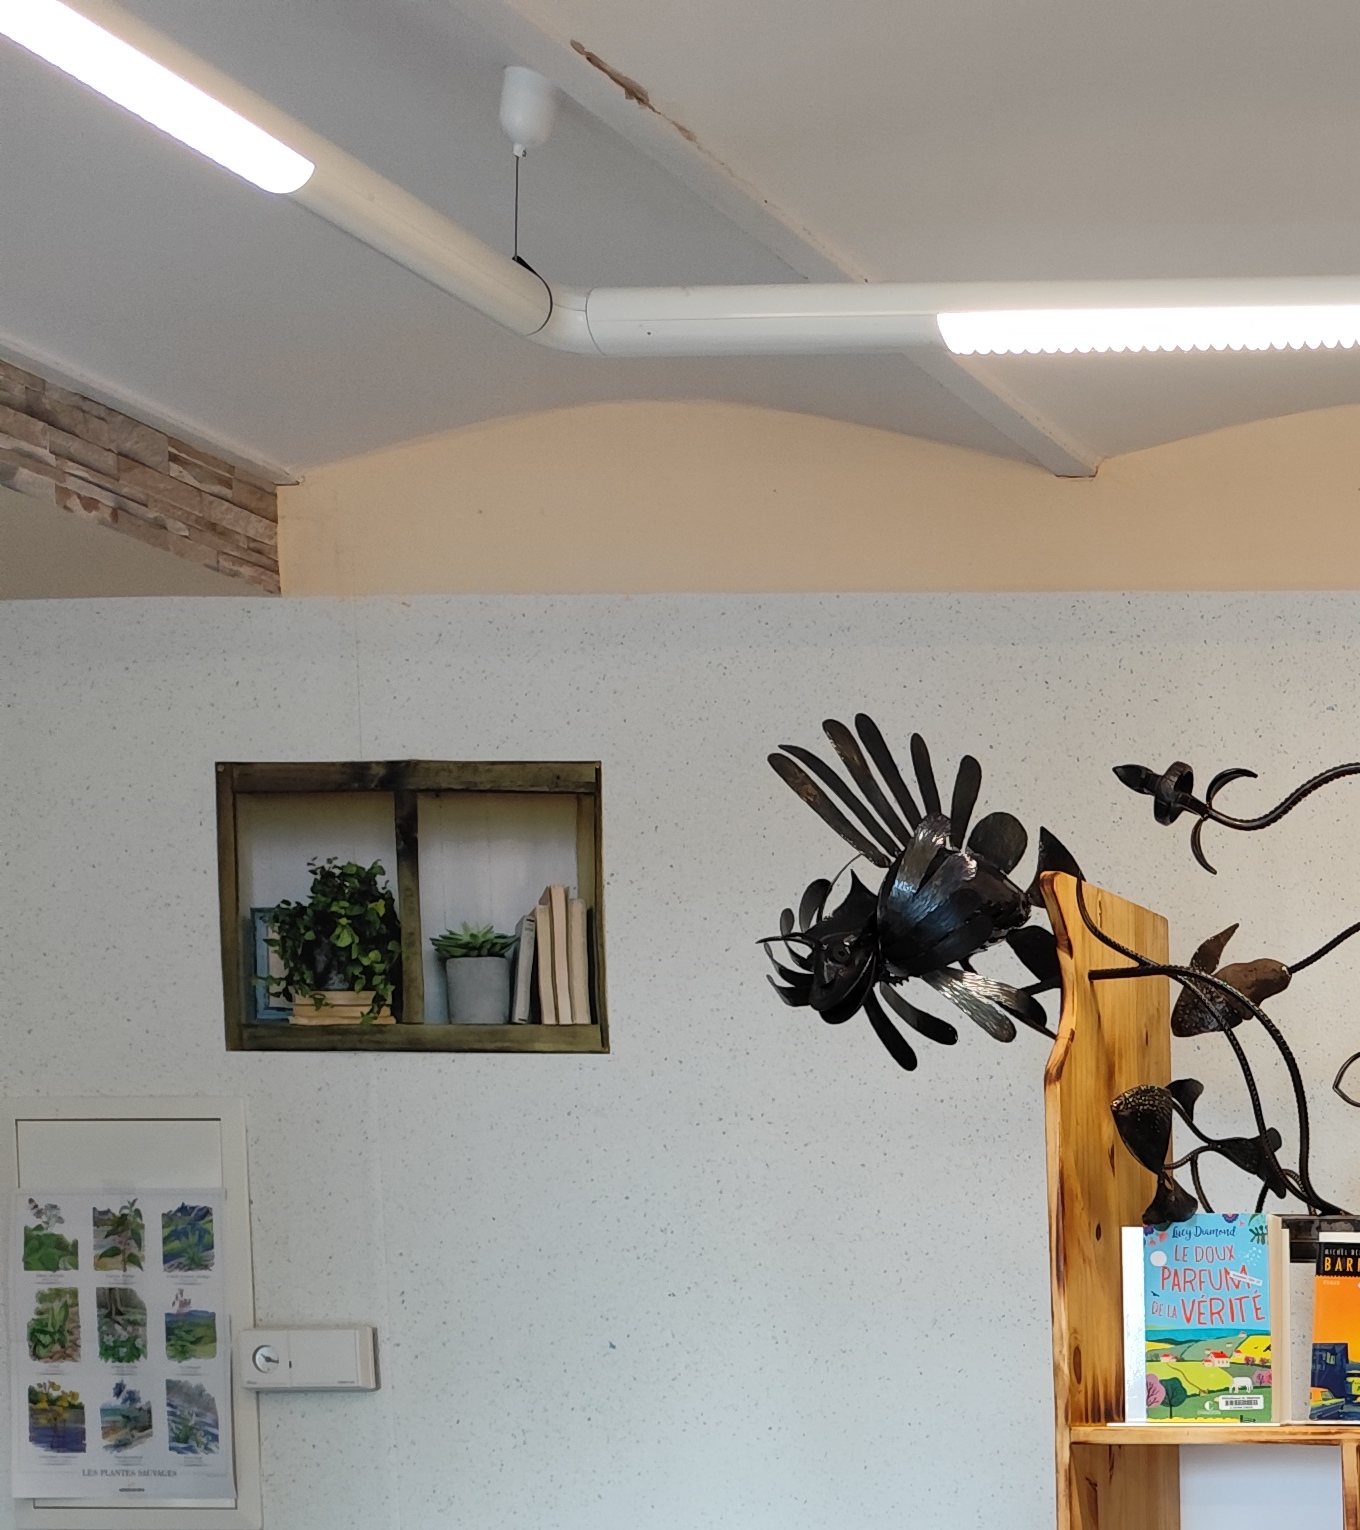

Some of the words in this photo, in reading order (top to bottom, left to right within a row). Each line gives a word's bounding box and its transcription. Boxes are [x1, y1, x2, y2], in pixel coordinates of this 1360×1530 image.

[1172, 1226, 1192, 1241] Lucy
[1194, 1225, 1237, 1237] Diamond
[1174, 1244, 1189, 1262] LE
[1195, 1244, 1235, 1264] DOUX
[1161, 1264, 1251, 1292] PARFUM
[1151, 1301, 1163, 1317] DE
[1167, 1305, 1177, 1318] LA
[1181, 1290, 1266, 1326] VÉRITÉ
[82, 1469, 98, 1477] LES
[100, 1469, 136, 1477] PLANTES
